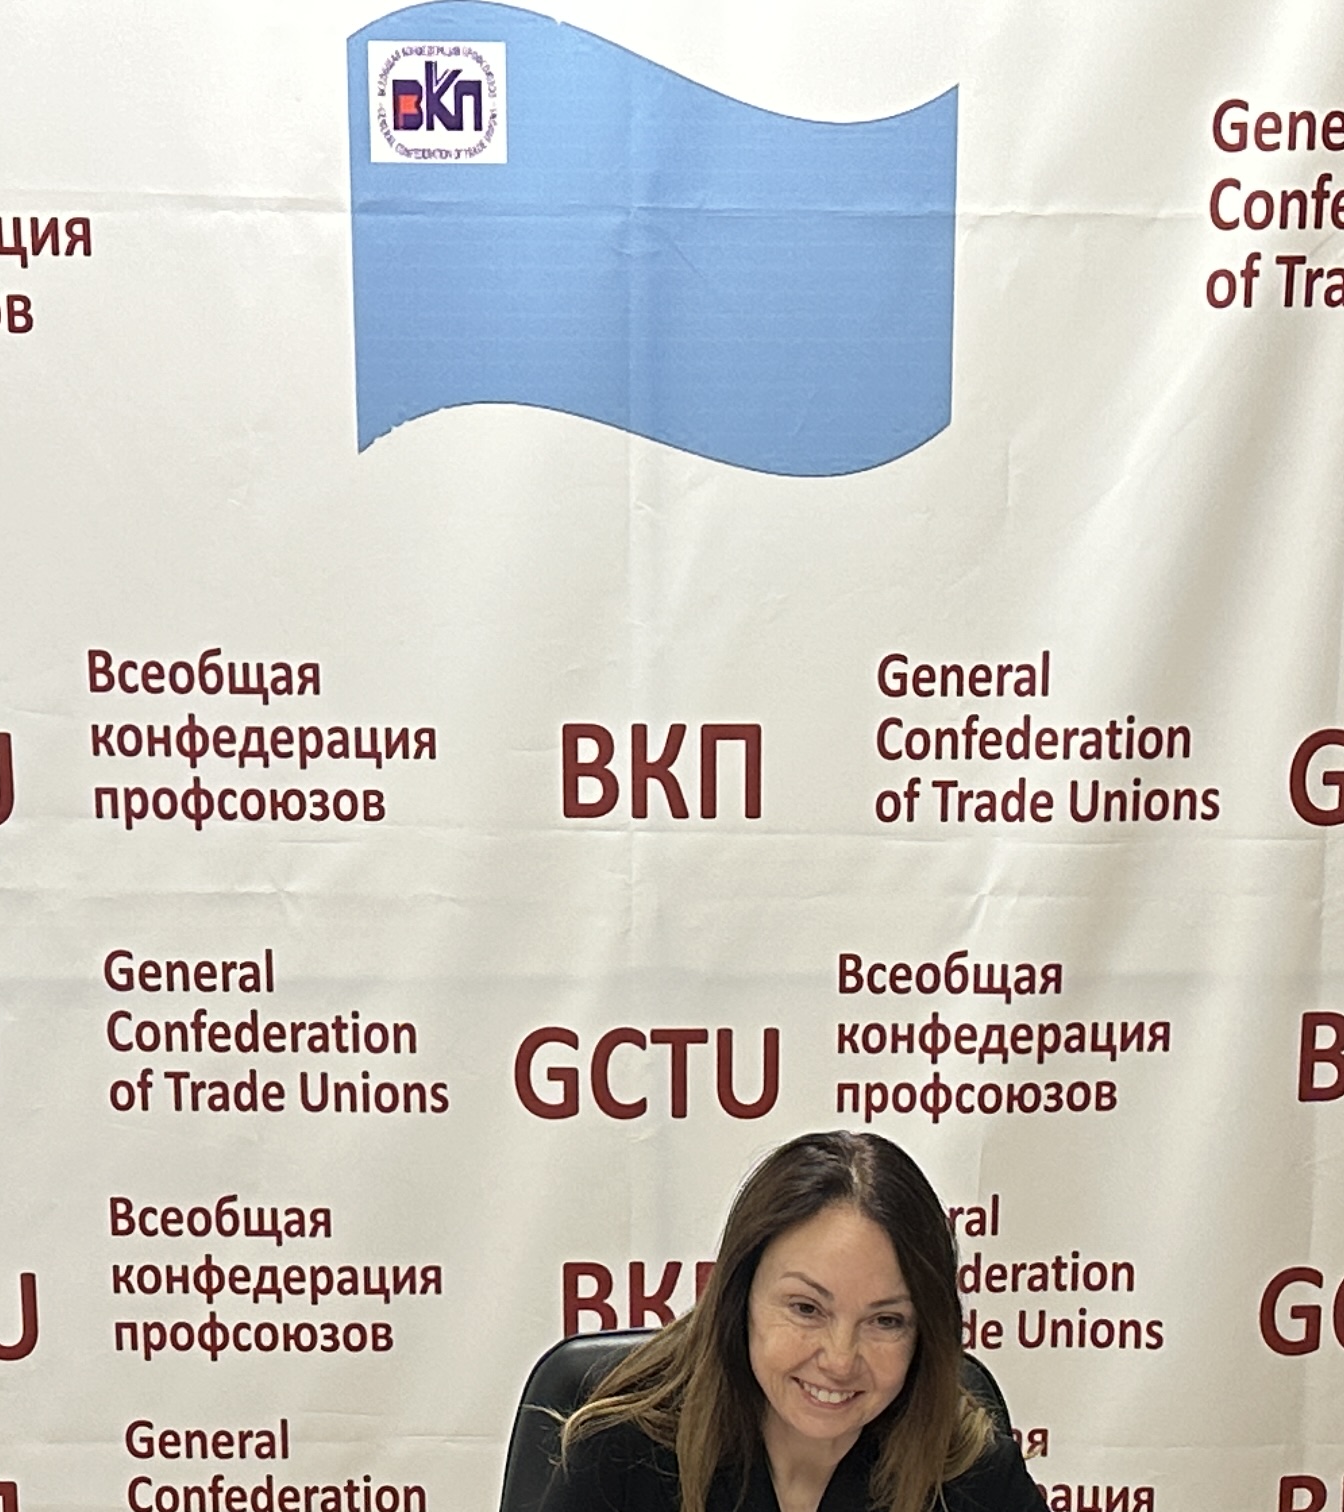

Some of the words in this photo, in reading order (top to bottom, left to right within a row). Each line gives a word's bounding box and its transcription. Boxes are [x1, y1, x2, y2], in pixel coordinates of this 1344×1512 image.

[1205, 251, 1262, 310] of
[87, 647, 320, 704] Всеобщая
[877, 651, 1050, 699] General
[90, 713, 436, 769] конфедерация
[876, 714, 1191, 761] Confederation
[561, 722, 763, 820] ВКП
[94, 776, 386, 830] профсоюзов
[874, 777, 920, 823] of
[931, 778, 1055, 824] Trade
[1069, 778, 1219, 824] Unions
[103, 948, 274, 993] General
[838, 949, 1063, 1002] Всеобщая
[106, 1008, 417, 1055] Confederation
[837, 1012, 1170, 1063] конфедерация
[109, 1068, 152, 1112] of
[165, 1070, 285, 1113] Trade
[299, 1071, 450, 1114] Unions
[513, 1025, 780, 1121] GCTU
[836, 1073, 1117, 1123] профсоюзов
[109, 1194, 332, 1246] Всеобщая
[111, 1256, 442, 1304] конфедерация
[957, 1252, 1135, 1294] deration
[114, 1312, 394, 1361] профсоюзов
[1017, 1308, 1164, 1351] Unions
[124, 1419, 289, 1460] General
